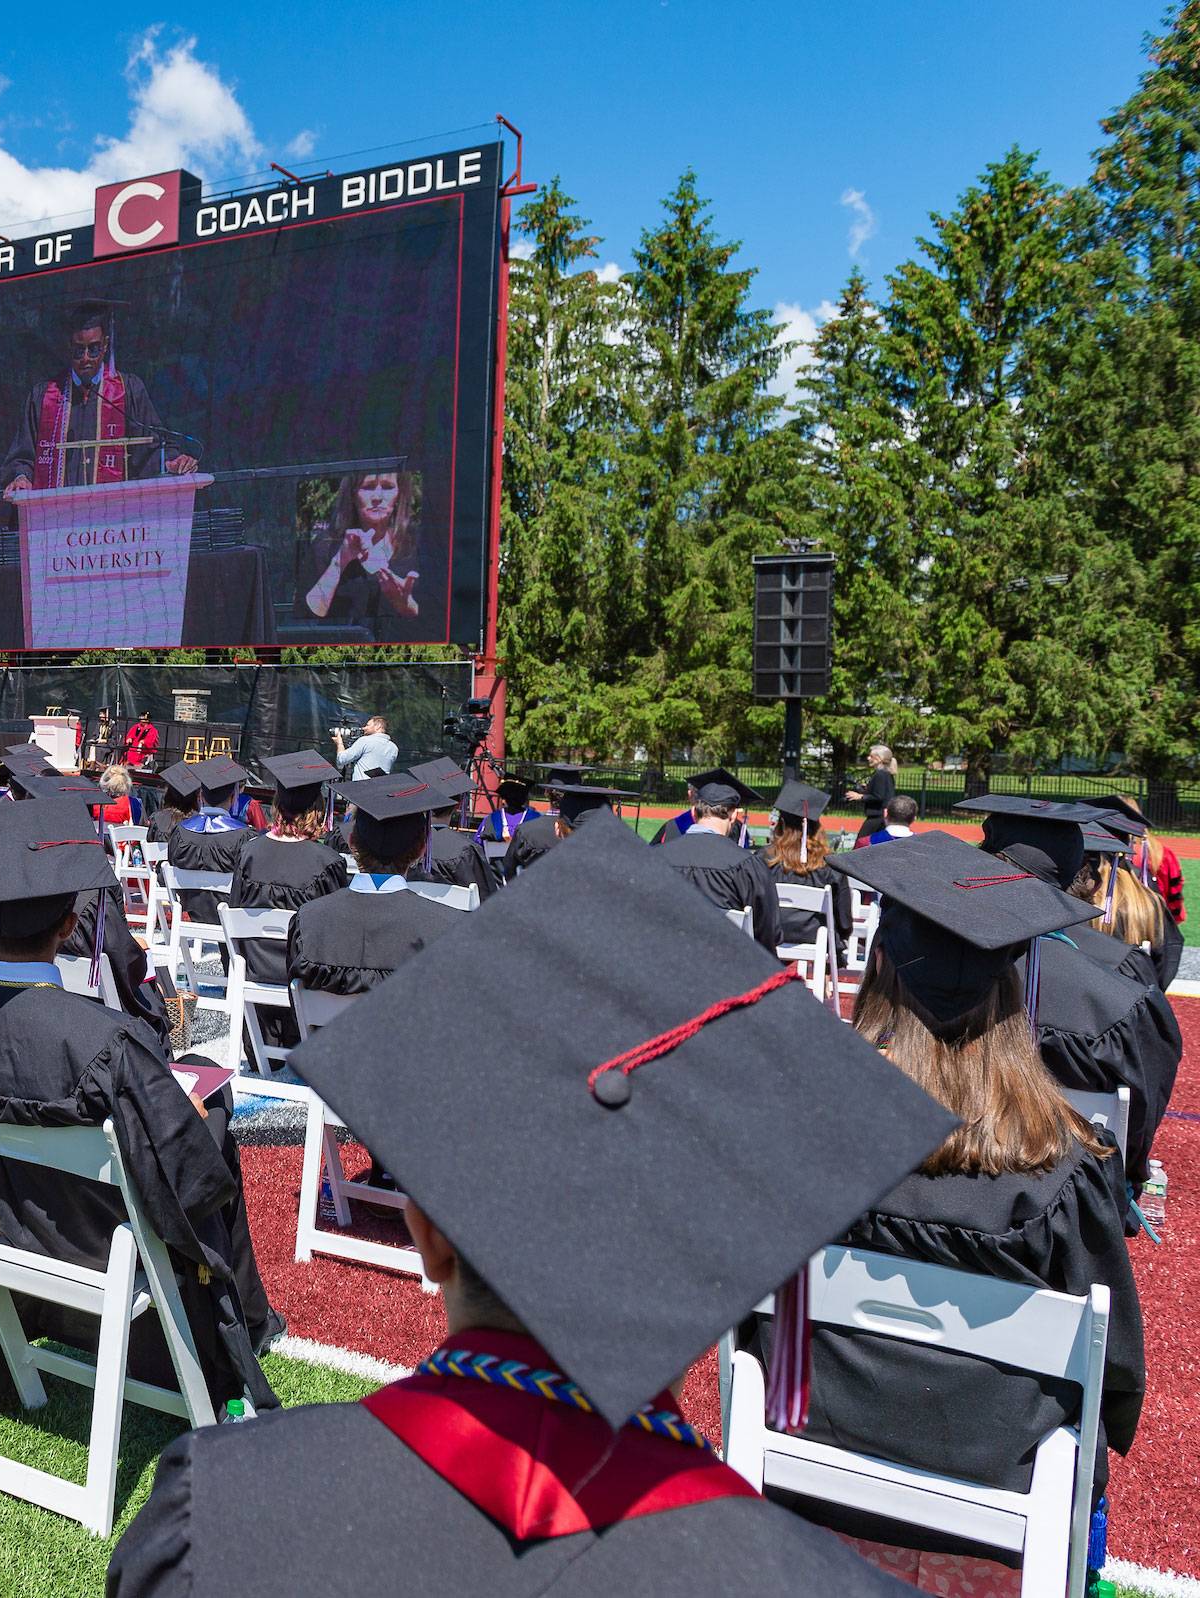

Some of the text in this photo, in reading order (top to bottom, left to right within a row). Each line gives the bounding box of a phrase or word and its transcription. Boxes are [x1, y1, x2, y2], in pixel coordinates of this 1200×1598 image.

[34, 234, 72, 266] OF
[196, 186, 315, 237] COACH
[342, 151, 482, 209] BIDDLE
[107, 181, 166, 247] C
[106, 423, 117, 437] T
[105, 454, 116, 468] H
[66, 527, 151, 548] COLGATE
[52, 550, 166, 572] UNIVERSITY
